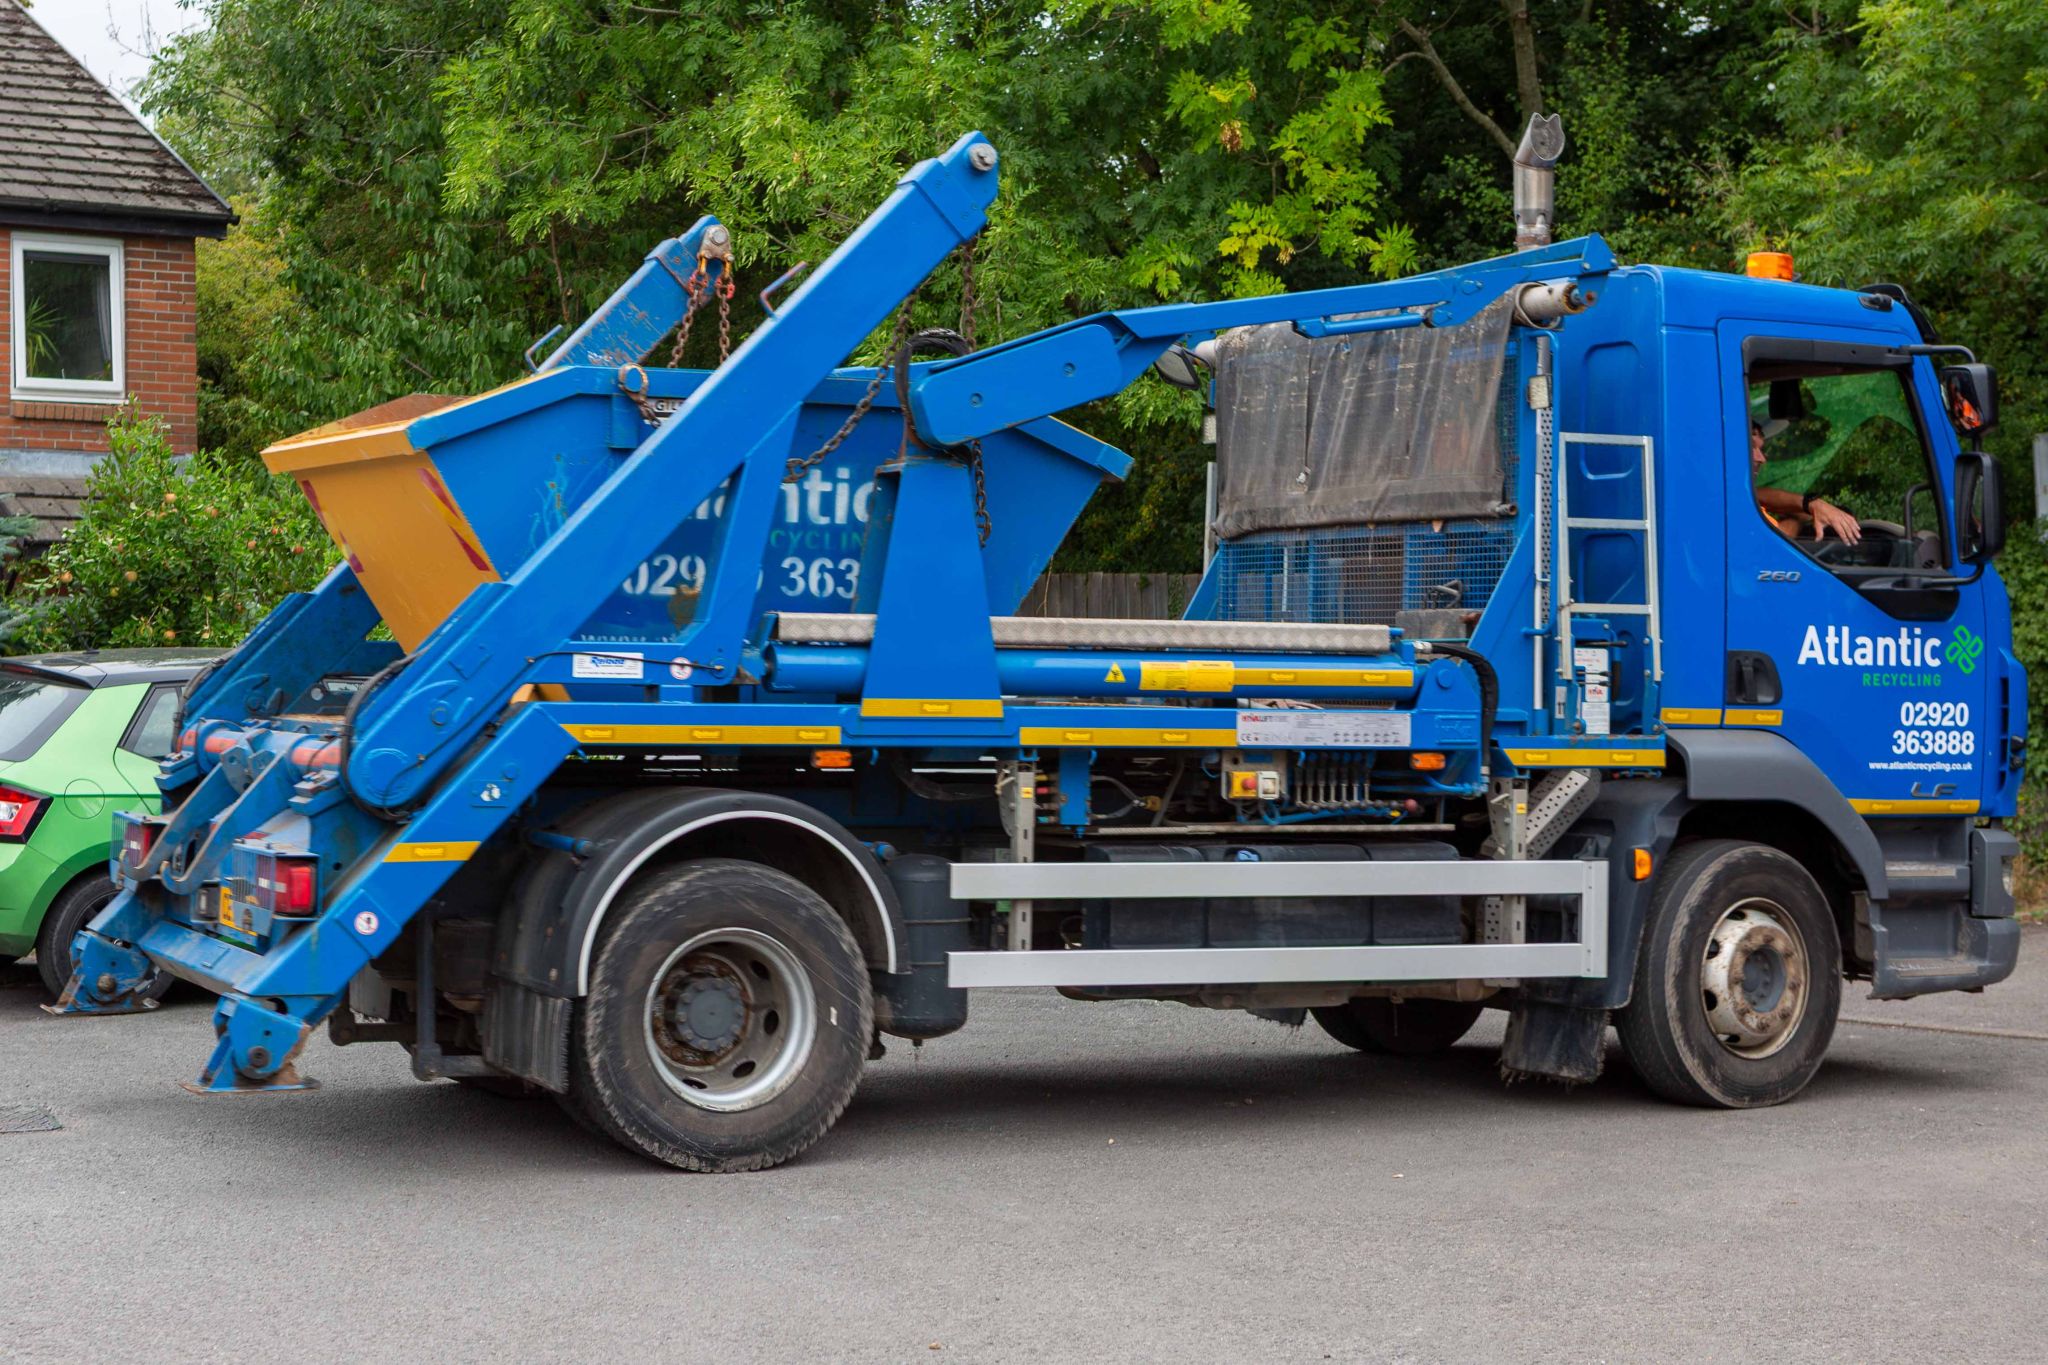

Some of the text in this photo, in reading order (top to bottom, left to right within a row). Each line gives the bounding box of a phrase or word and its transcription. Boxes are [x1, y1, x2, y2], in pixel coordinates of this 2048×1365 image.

[769, 529, 865, 552] CYCLIN
[780, 556, 861, 599] 363
[1757, 570, 1801, 582] 260
[1797, 624, 1942, 668] Atlantic
[1862, 672, 1942, 687] RECYCLING
[1900, 701, 1970, 727] 02920
[1891, 729, 1975, 756] 363888
[1868, 761, 1973, 773] www.atlanticrecycling.co.uk
[1911, 781, 1957, 798] LF
